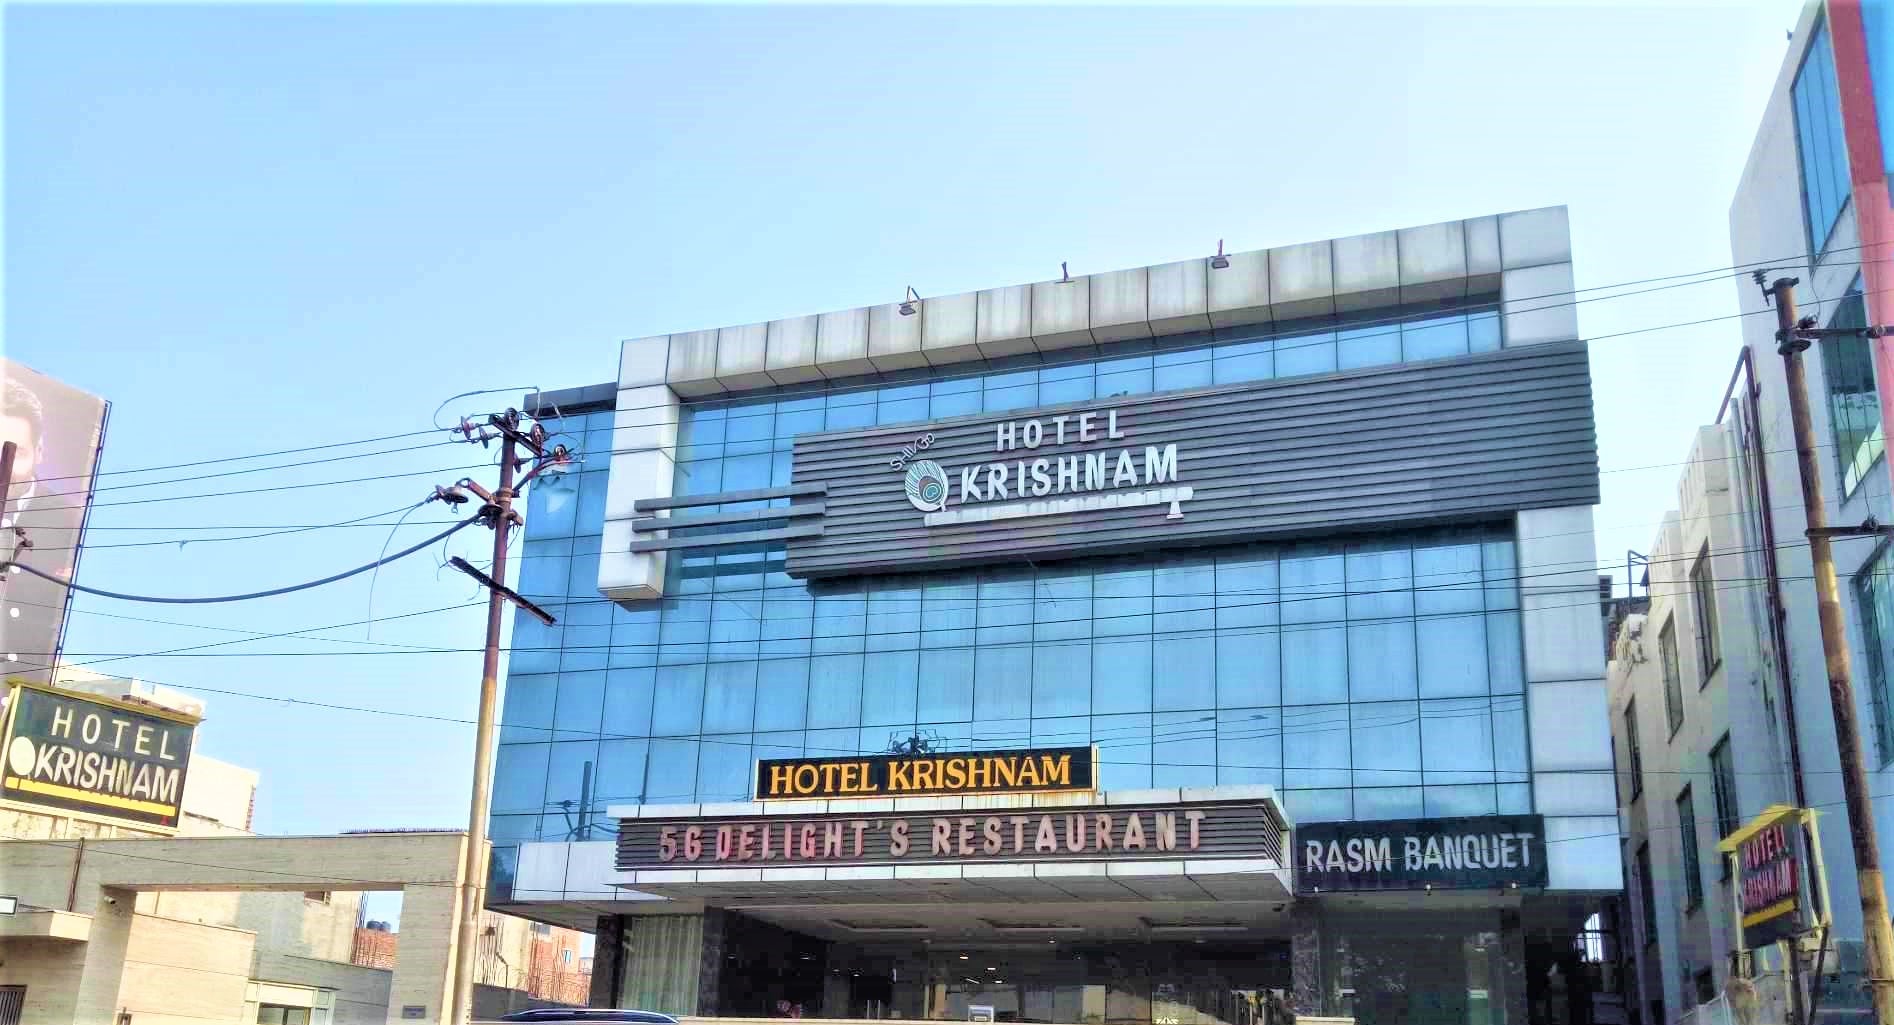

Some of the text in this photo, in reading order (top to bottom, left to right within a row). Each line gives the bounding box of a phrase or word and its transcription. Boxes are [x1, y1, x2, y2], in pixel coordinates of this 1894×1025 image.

[996, 409, 1125, 451] HOTEL
[961, 443, 1177, 503] KRISHNAM
[51, 706, 176, 761] HOTEL
[34, 743, 180, 803] KRISHNAM
[769, 755, 1072, 795] HOTEL KRISHNAM
[659, 811, 1205, 862] 56 DELIGHT'S RESTAURANT
[1306, 832, 1536, 873] RASM BANQUET
